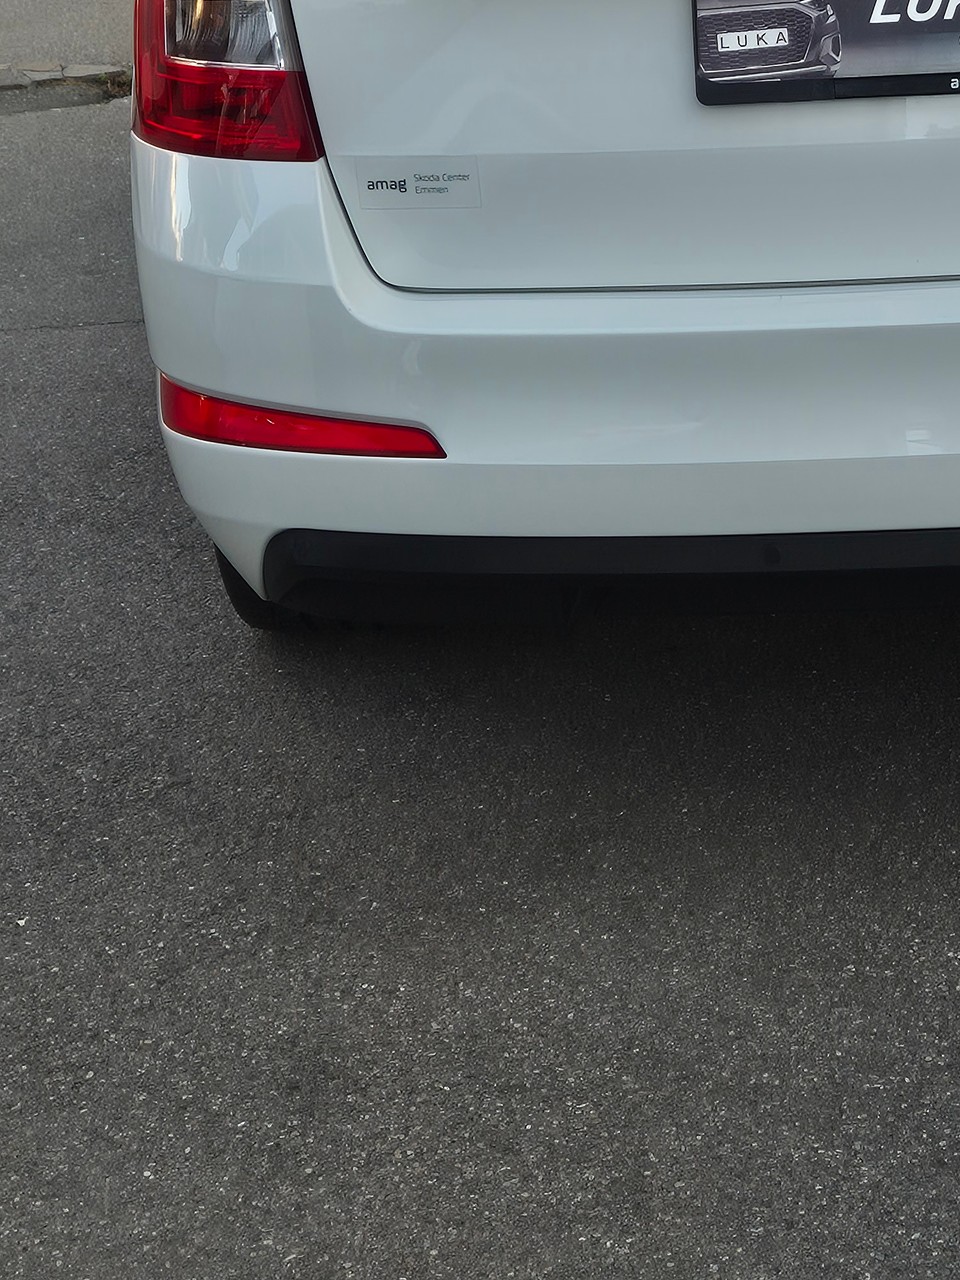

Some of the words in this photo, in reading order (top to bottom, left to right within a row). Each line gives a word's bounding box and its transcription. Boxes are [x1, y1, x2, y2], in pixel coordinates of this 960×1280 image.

[720, 31, 788, 49] LUKA
[442, 173, 470, 182] Center
[367, 178, 407, 193] amag
[415, 185, 449, 195] Emmen
